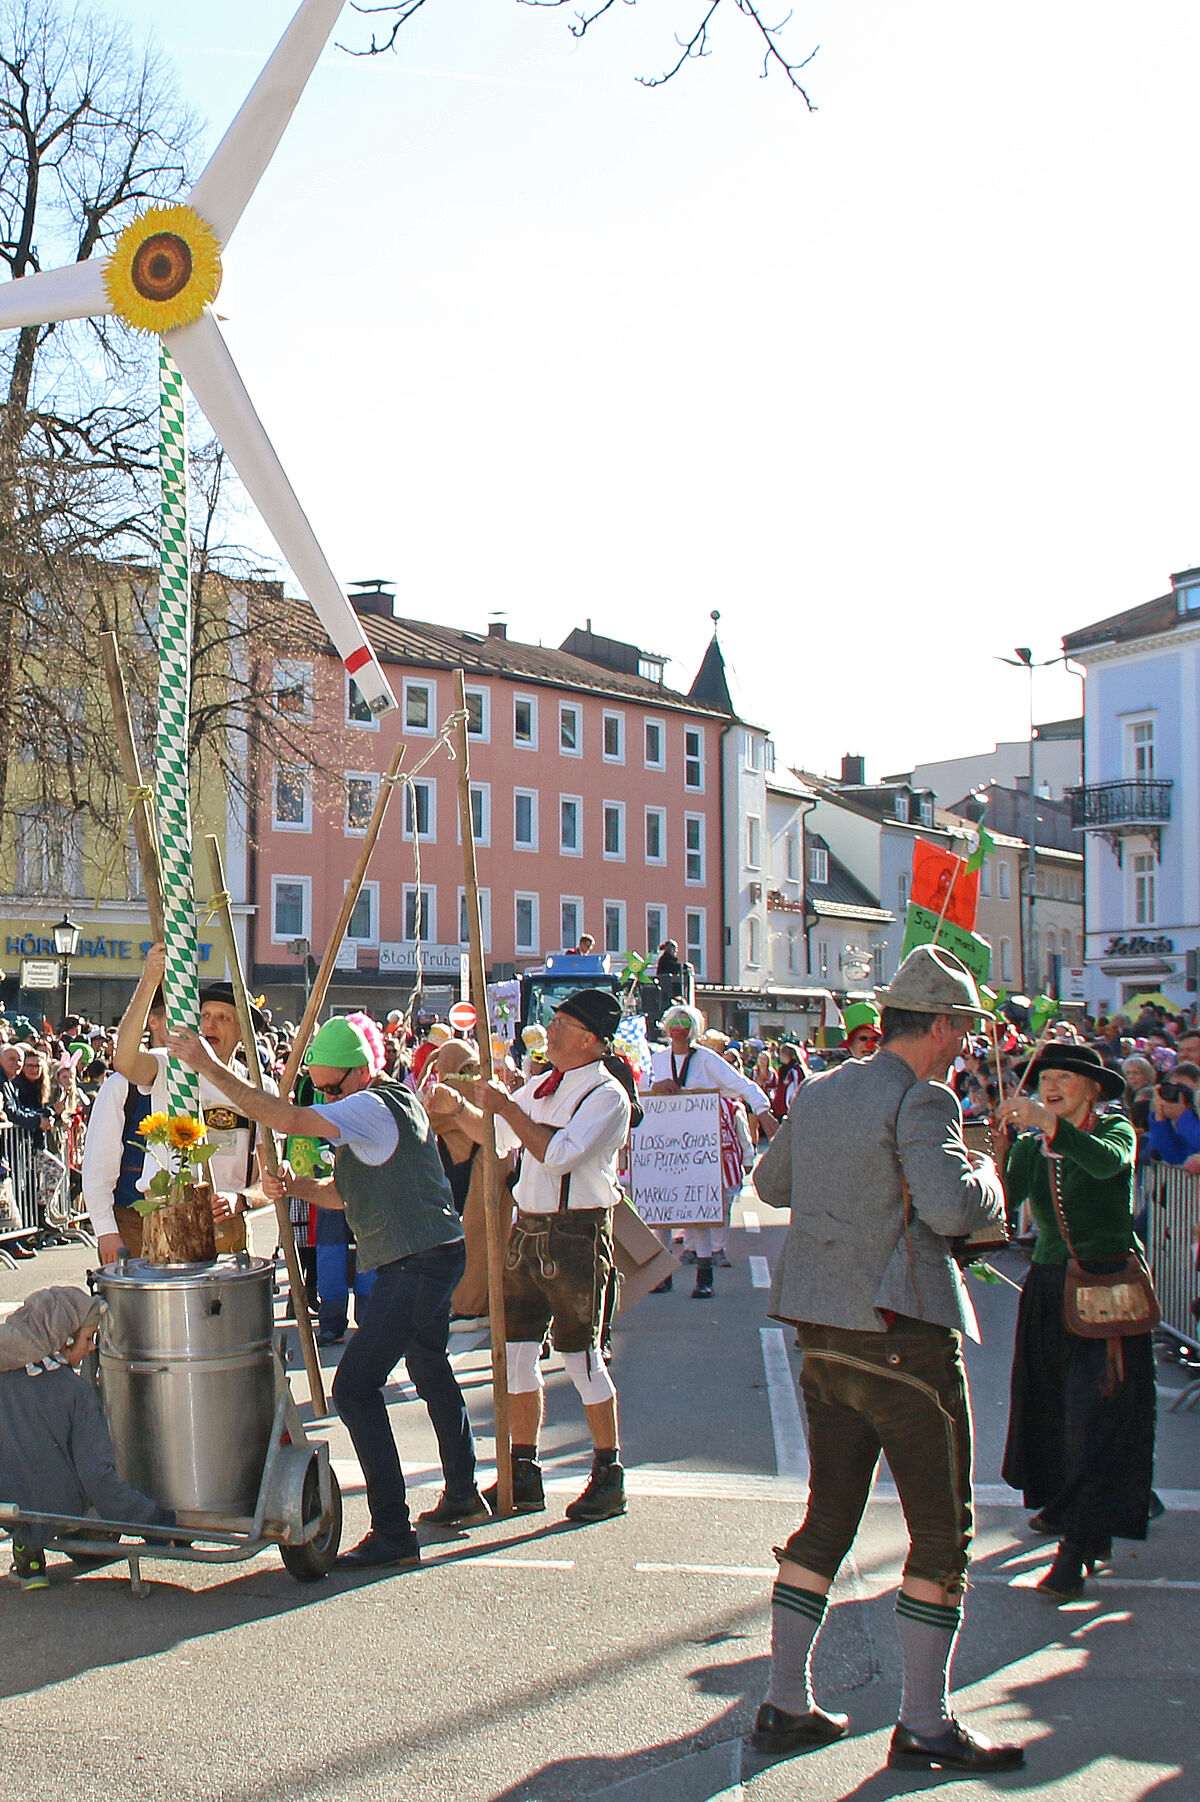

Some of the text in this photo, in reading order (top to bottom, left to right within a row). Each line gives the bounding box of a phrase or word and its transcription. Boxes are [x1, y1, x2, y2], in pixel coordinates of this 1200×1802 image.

[421, 951, 459, 967] Truhe
[684, 1097, 717, 1112] DANK
[633, 1150, 719, 1167] AUF PUTINS GAS
[633, 1184, 719, 1204] MARKUS ZEFIX
[638, 1205, 673, 1221] DANKE
[696, 1205, 721, 1219] NIX
